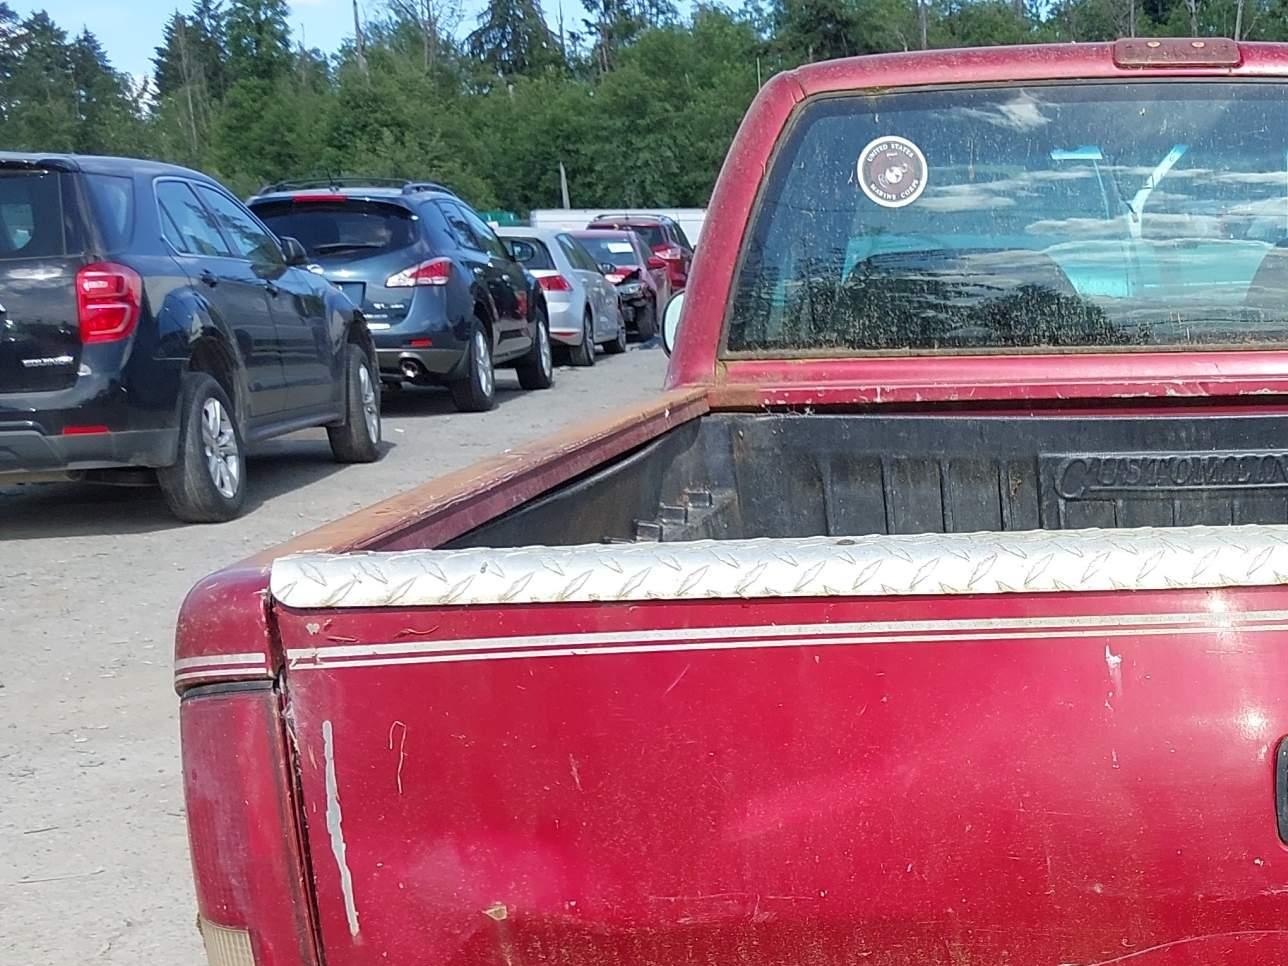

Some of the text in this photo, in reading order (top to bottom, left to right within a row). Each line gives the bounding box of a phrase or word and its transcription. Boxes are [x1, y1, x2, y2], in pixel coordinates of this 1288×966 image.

[867, 143, 914, 162] UNITED STATES
[870, 183, 896, 200] MARINE
